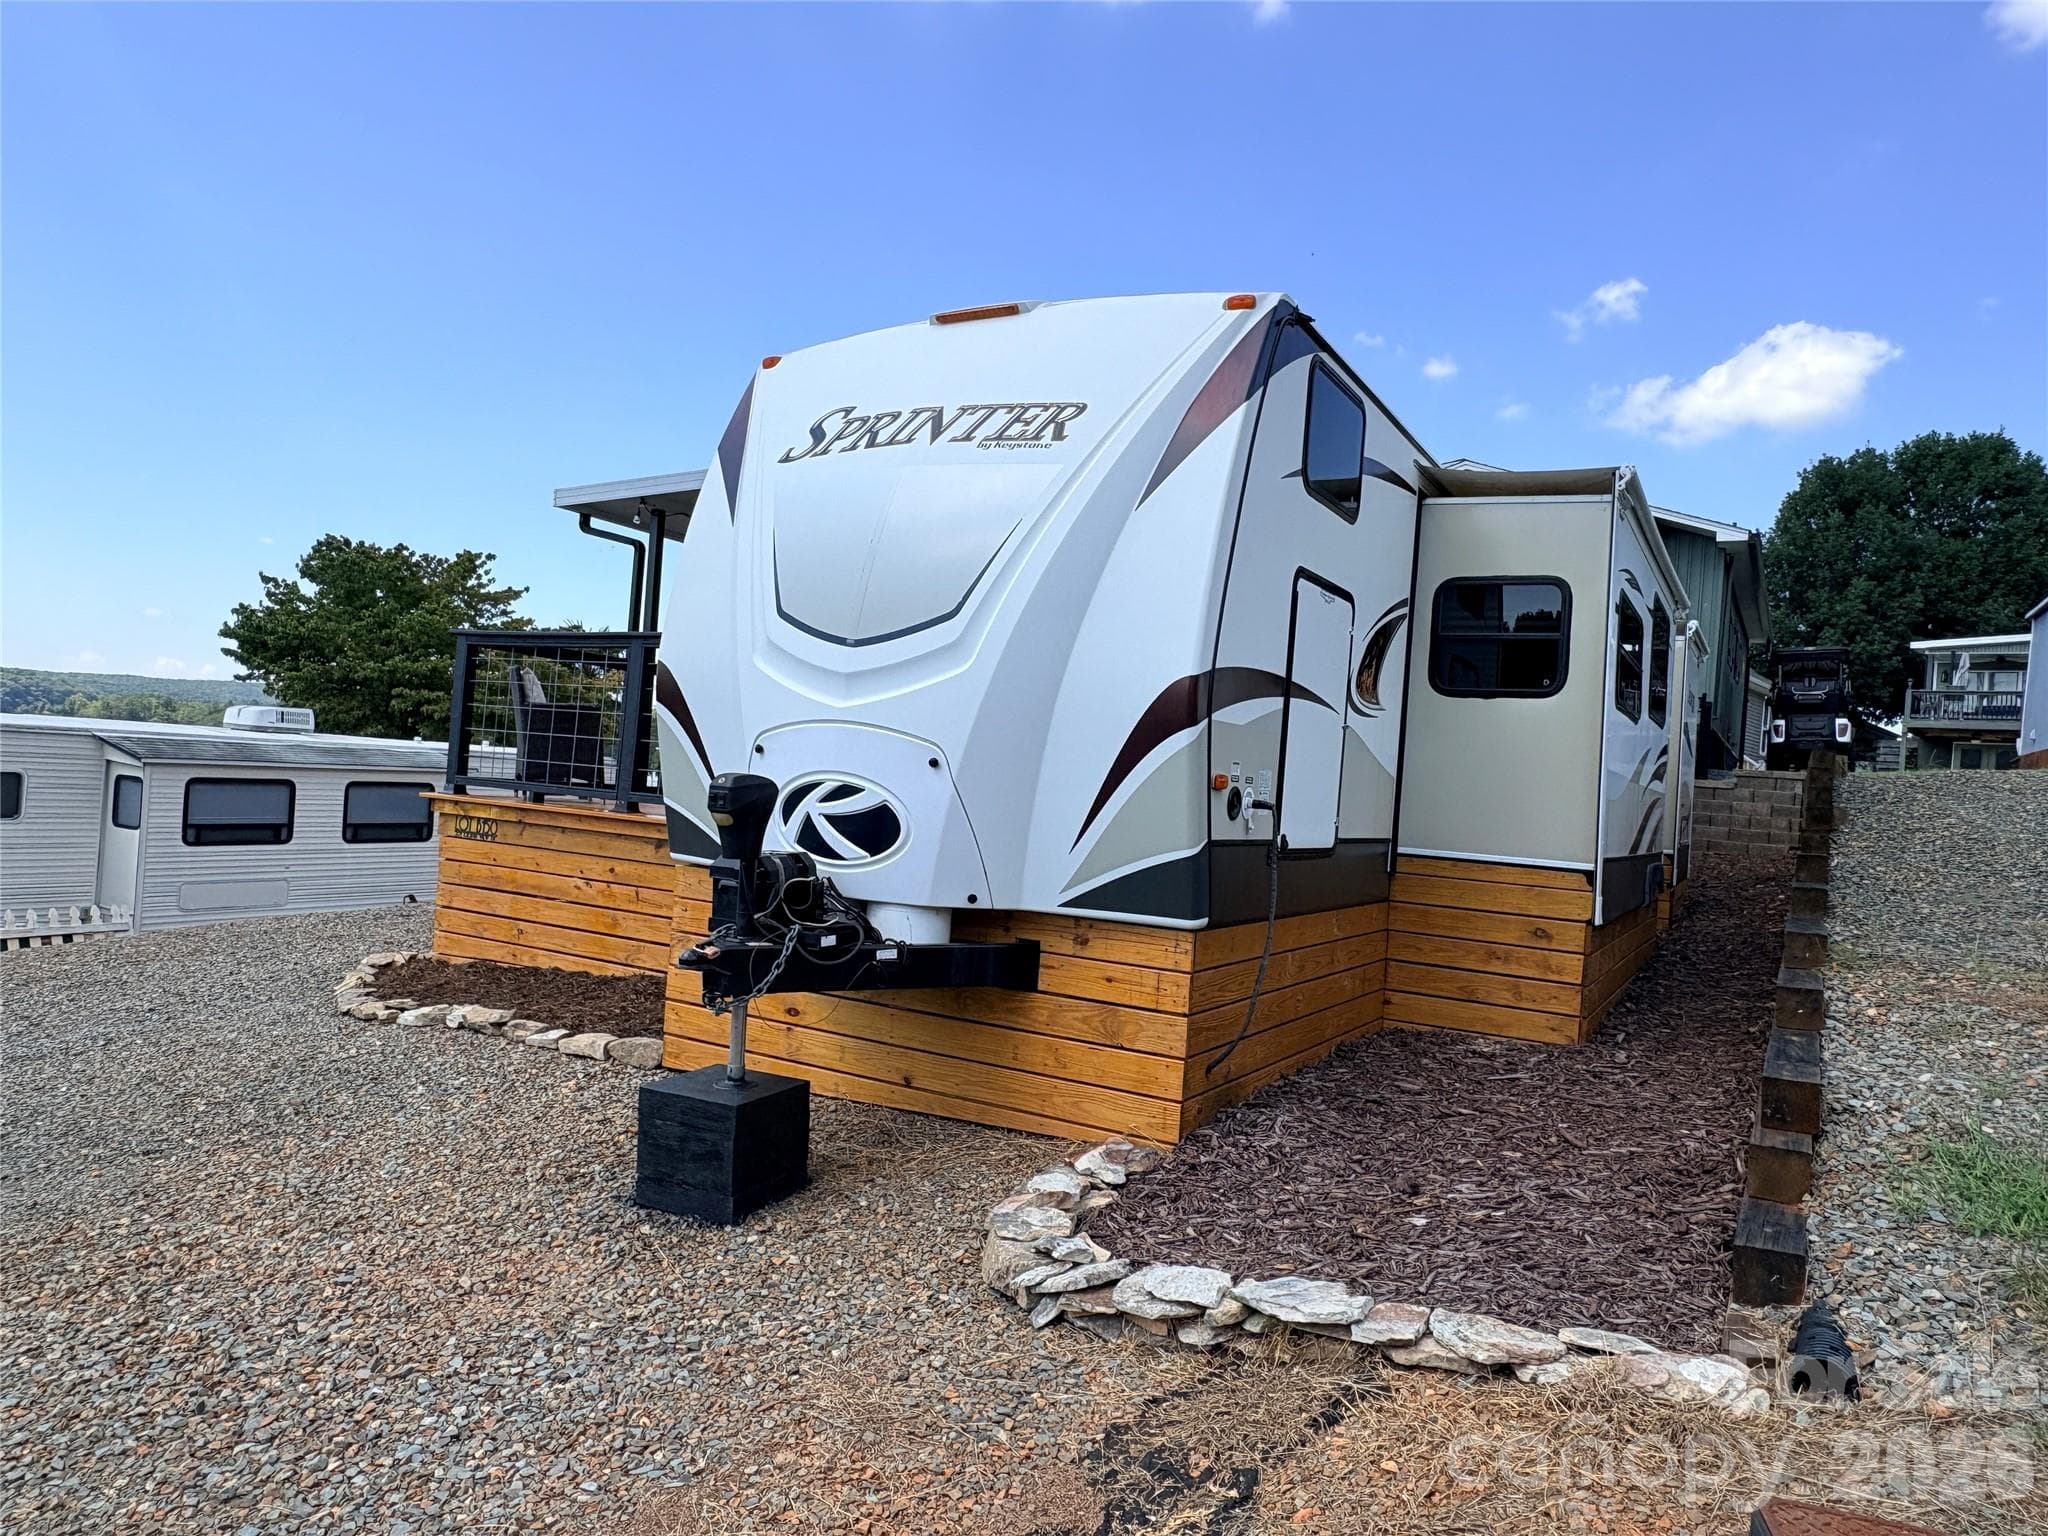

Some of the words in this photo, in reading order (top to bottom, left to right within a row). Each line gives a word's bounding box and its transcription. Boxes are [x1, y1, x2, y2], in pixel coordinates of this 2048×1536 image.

[777, 402, 1087, 463] SPRINTER
[976, 440, 992, 450] by
[993, 440, 1052, 450] Keystone
